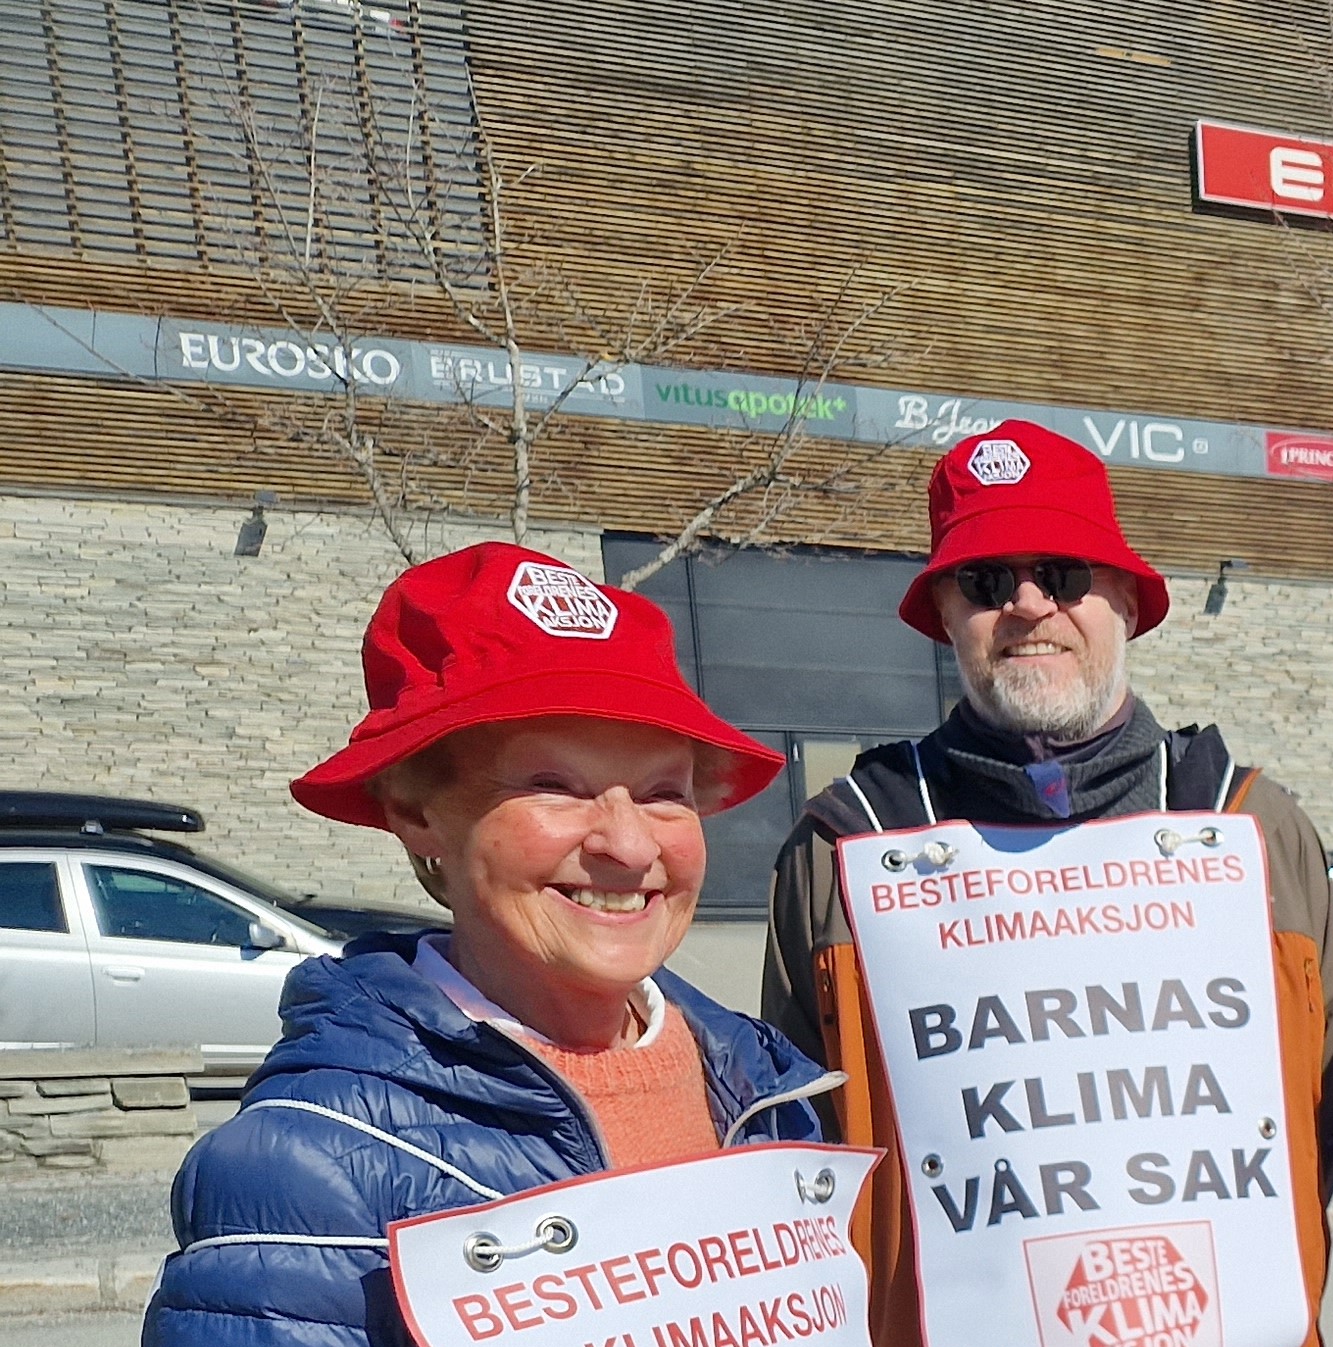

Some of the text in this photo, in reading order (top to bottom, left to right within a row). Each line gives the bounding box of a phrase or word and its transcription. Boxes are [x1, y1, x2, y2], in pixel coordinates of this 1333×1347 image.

[179, 332, 400, 385] EUROSKO
[1083, 416, 1185, 463] VIC
[521, 594, 611, 621] KLIMA
[871, 855, 1246, 914] BESTEFORELDRENES
[938, 901, 1195, 949] KLIMAAKSJON
[908, 977, 1251, 1060] BARNAS
[960, 1063, 1233, 1140] KLIMA
[931, 1147, 1279, 1233] VÅR SAK
[452, 1215, 845, 1341] BESTEFORELDRENES
[1064, 1262, 1194, 1308] FORELDRENES
[1081, 1239, 1168, 1283] BESTE
[1066, 1290, 1202, 1346] KLIMA
